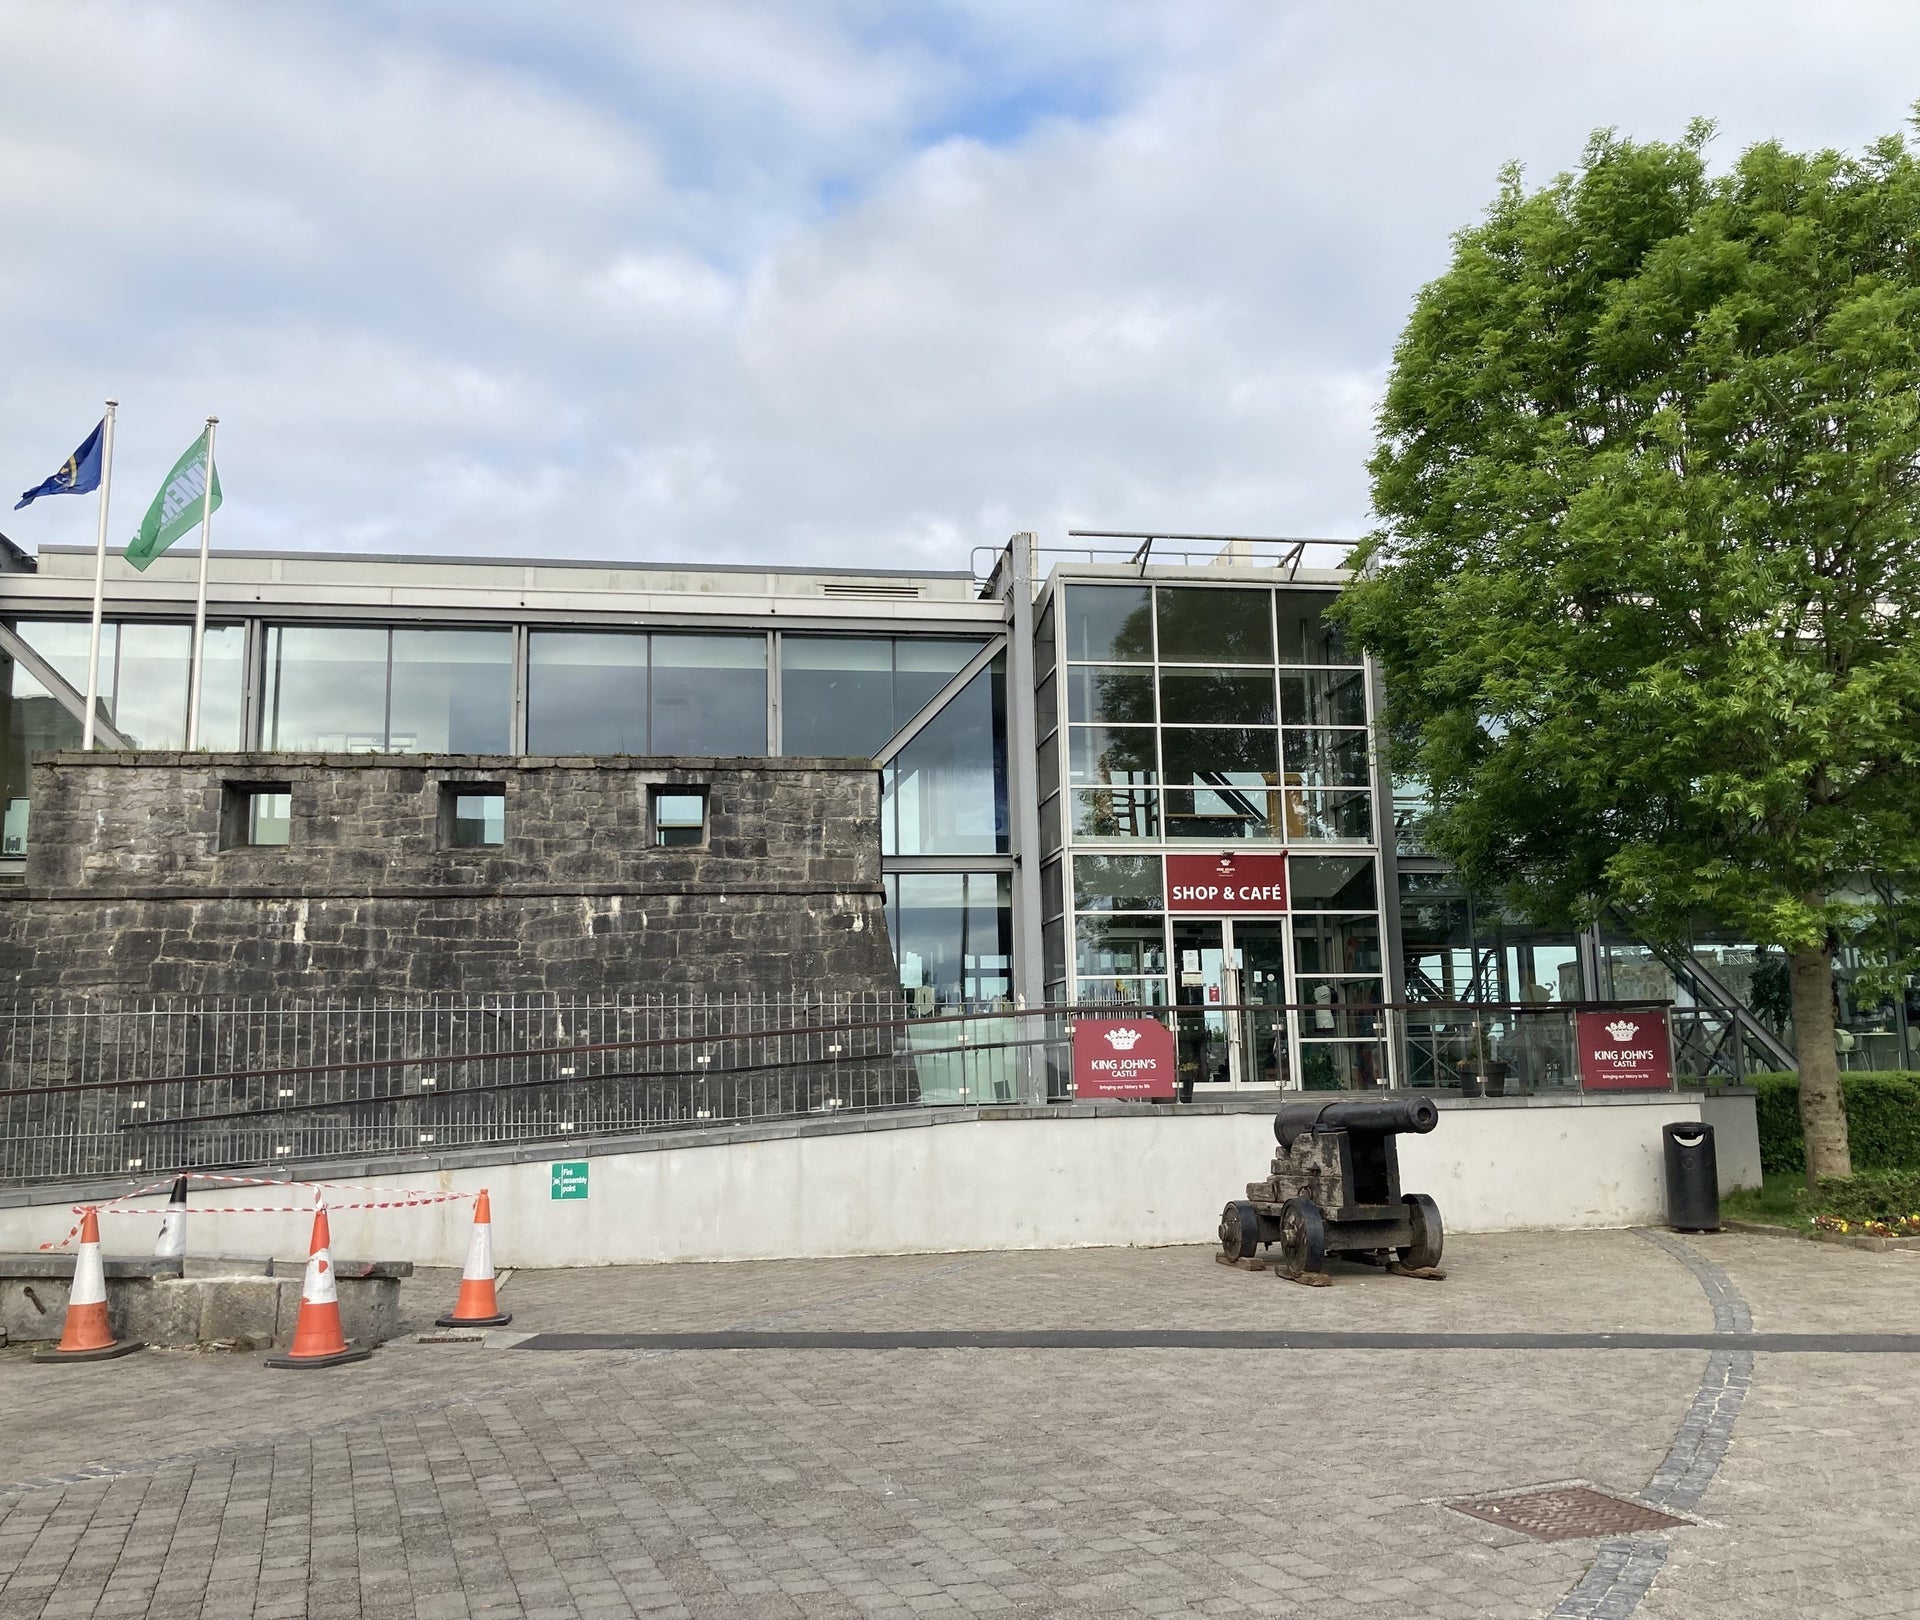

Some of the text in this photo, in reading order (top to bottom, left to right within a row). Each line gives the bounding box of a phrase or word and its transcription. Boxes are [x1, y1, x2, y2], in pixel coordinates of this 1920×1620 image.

[1172, 884, 1282, 900] SHOP & CAFÉ
[1595, 1050, 1654, 1060] KING JOHN'S
[1091, 1059, 1157, 1070] KING JOHN'S
[1613, 1060, 1637, 1068] CASTLE
[1111, 1070, 1138, 1078] CASTLE
[563, 1176, 587, 1185] assembly
[562, 1185, 576, 1194] point
